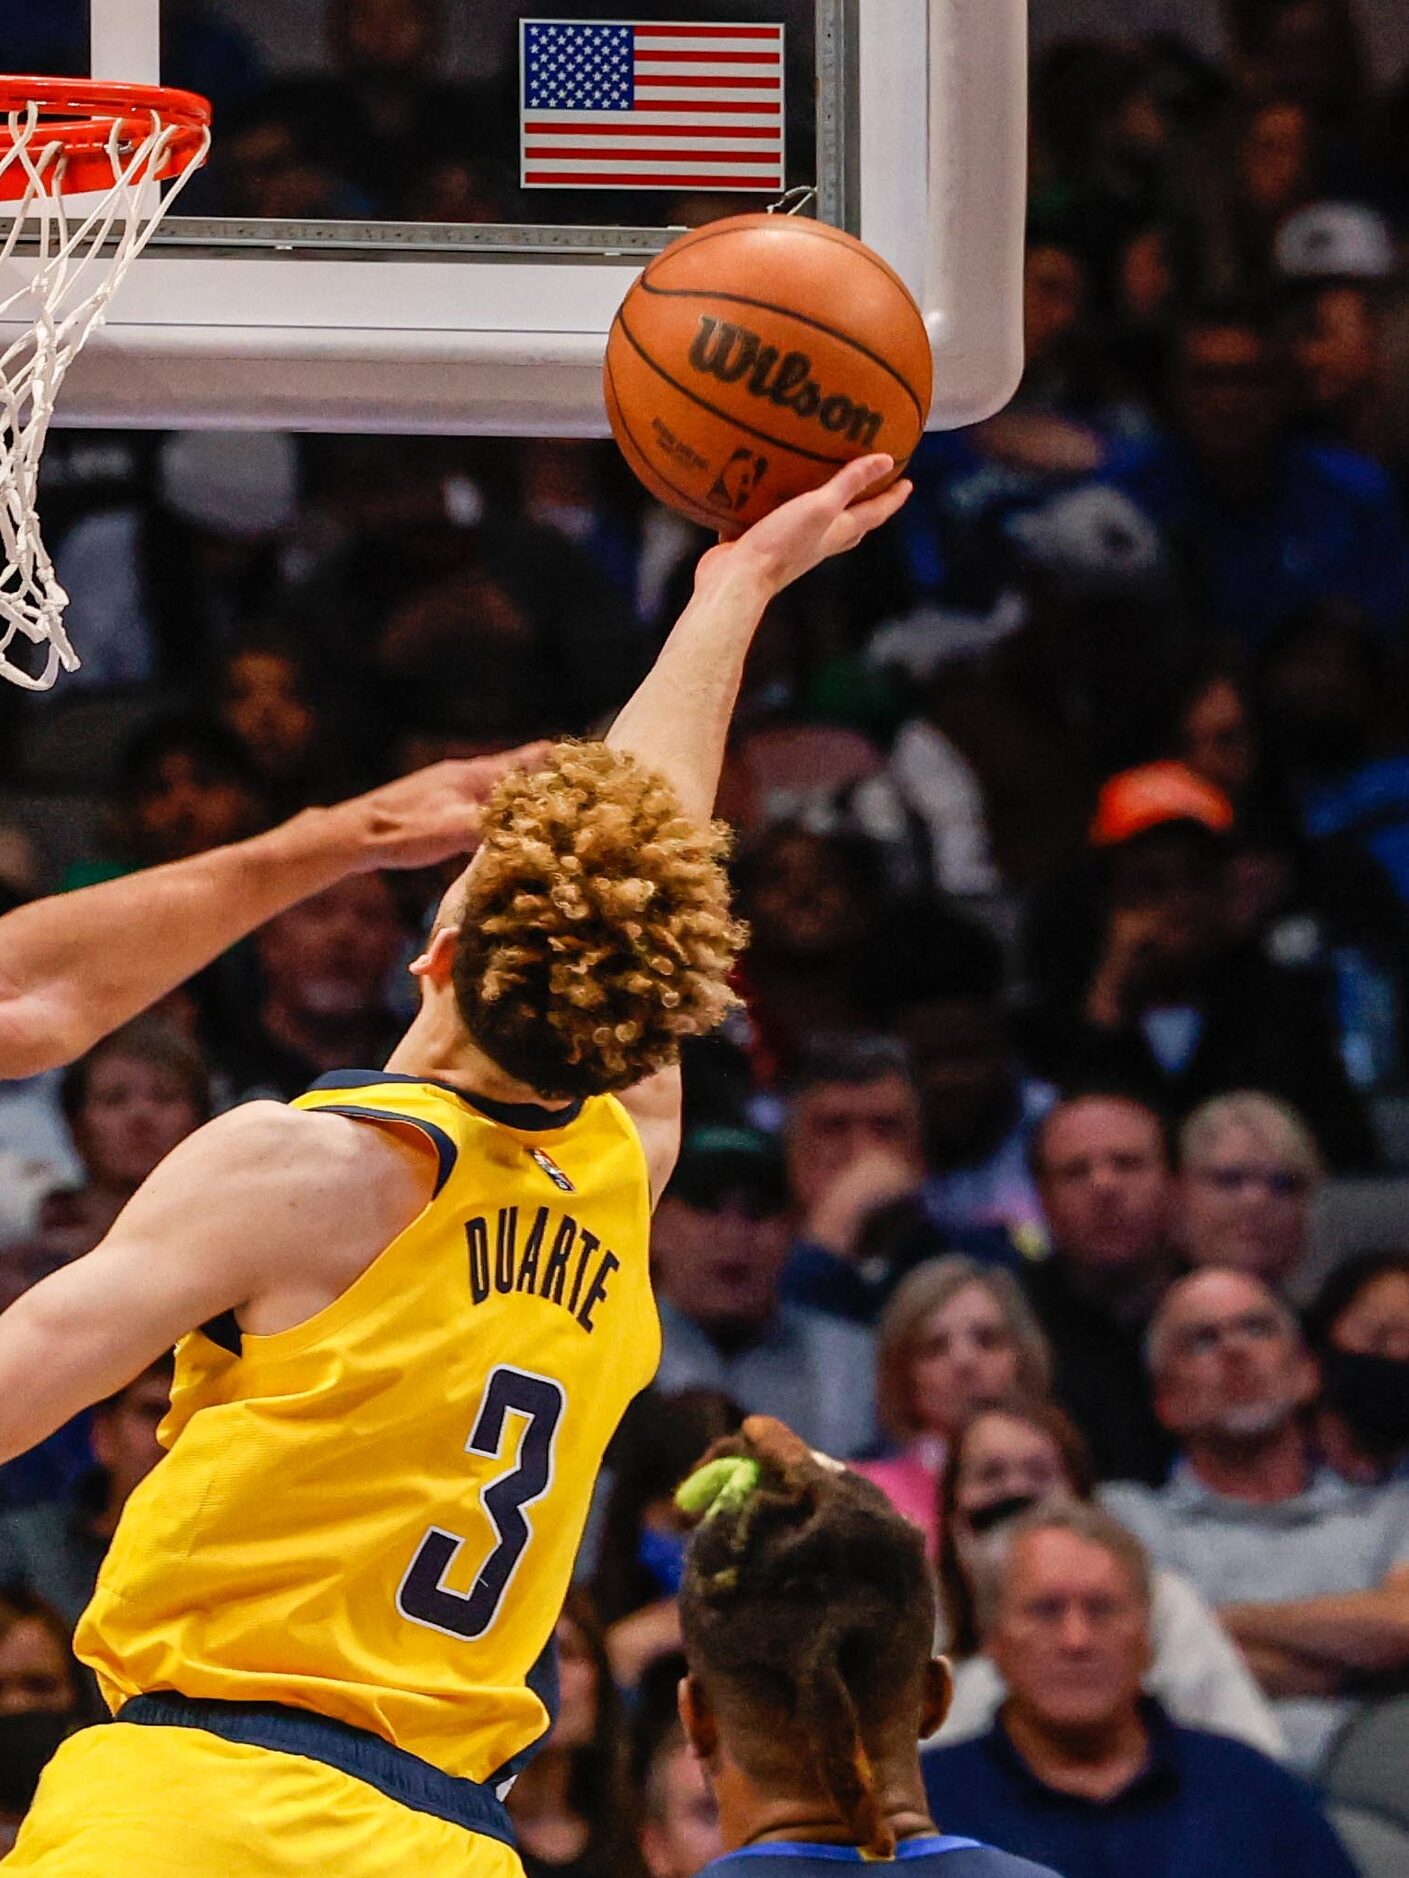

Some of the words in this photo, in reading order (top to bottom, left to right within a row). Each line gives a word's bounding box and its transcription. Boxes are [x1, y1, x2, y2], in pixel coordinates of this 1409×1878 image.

[688, 315, 884, 448] Wilson
[464, 1206, 621, 1334] DUARTE
[395, 1363, 568, 1643] 3
